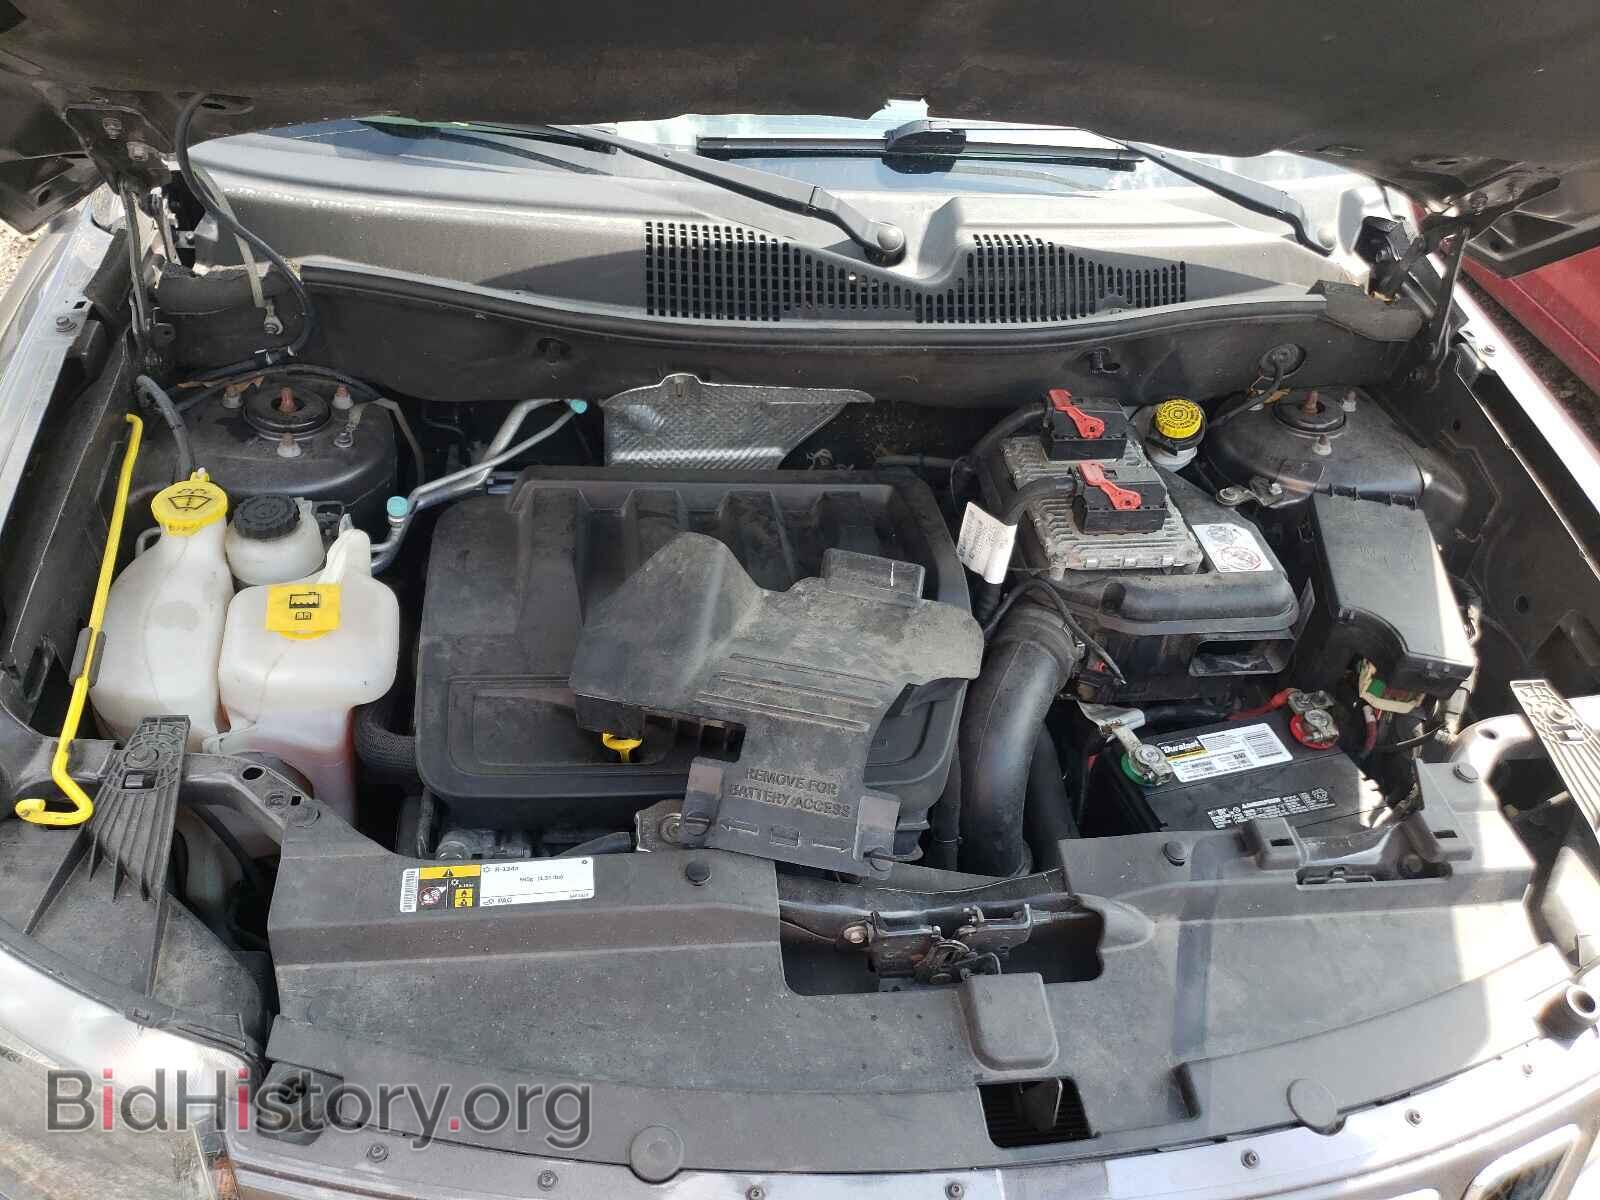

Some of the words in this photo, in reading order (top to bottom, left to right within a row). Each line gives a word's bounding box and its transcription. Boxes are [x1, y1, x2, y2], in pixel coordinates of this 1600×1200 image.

[1162, 740, 1201, 754] Duralast
[745, 767, 805, 790] REMOVE
[809, 779, 838, 797] FOR
[729, 783, 791, 807] BATTERY
[791, 796, 850, 818] ACCESS
